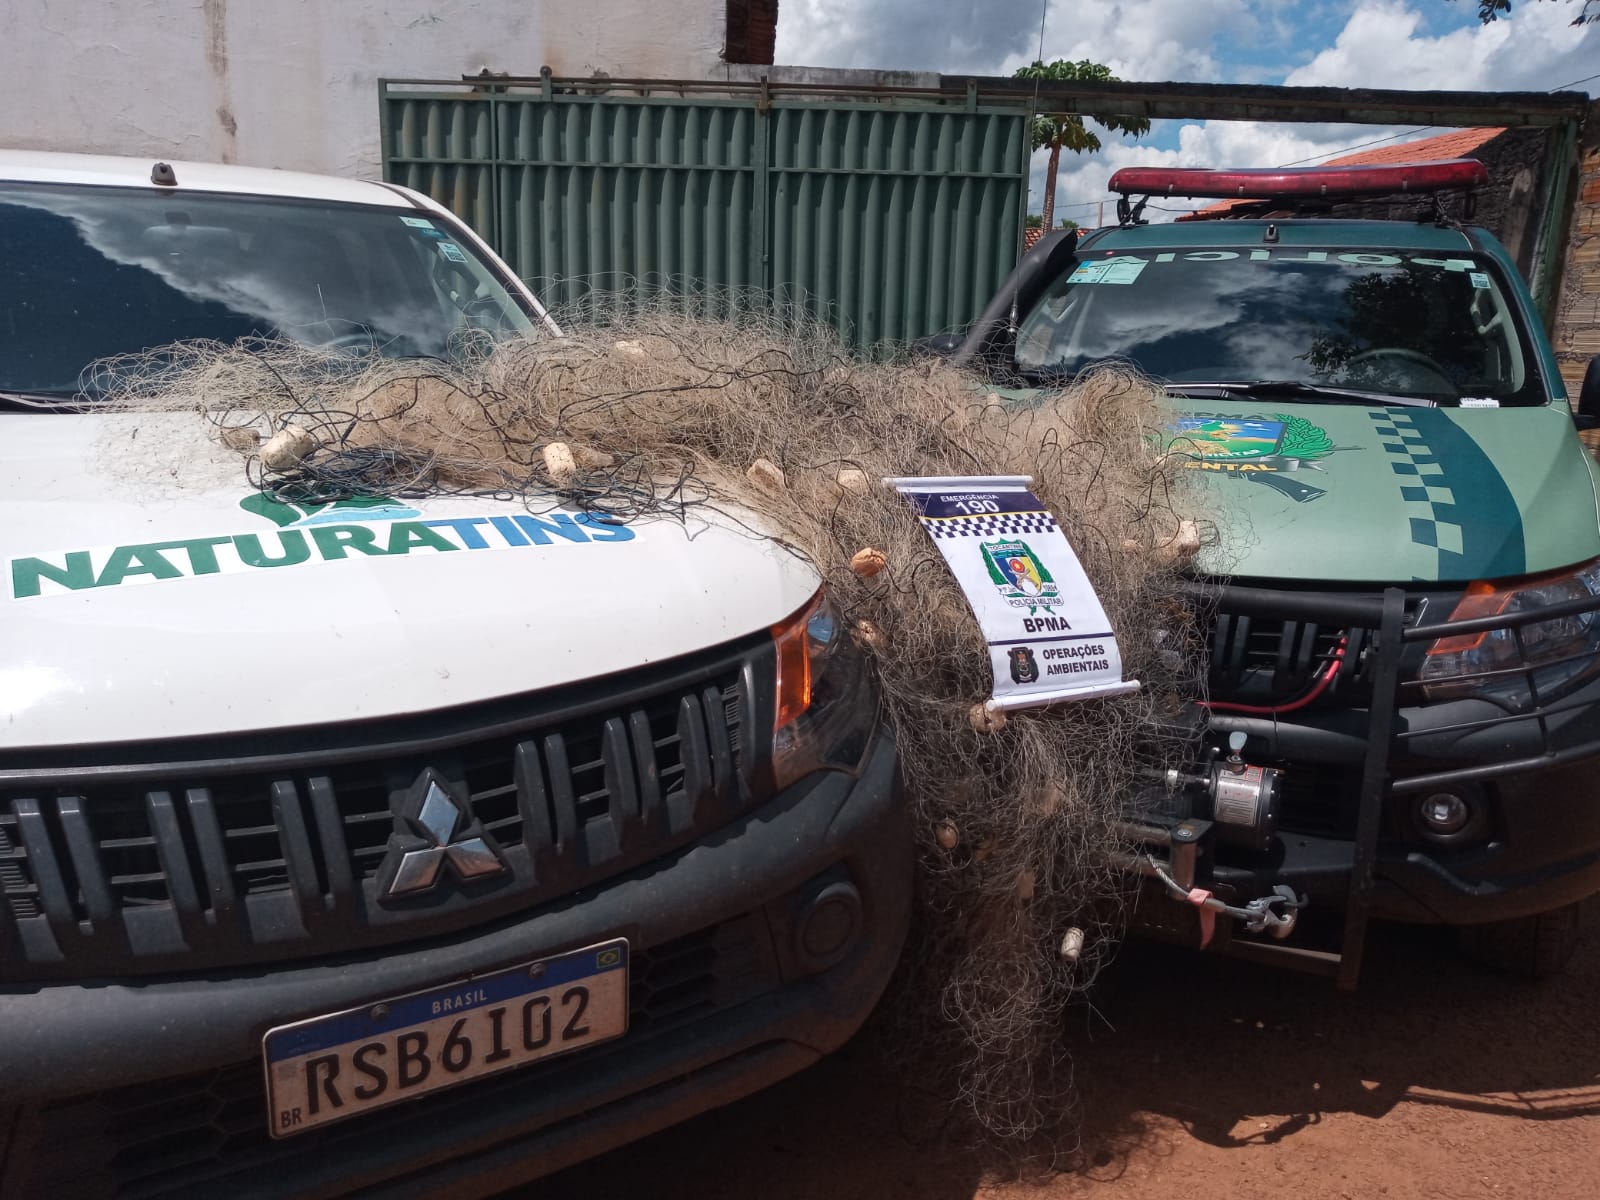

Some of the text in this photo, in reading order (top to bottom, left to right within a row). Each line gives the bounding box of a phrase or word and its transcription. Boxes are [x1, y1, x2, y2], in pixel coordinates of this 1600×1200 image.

[1184, 462, 1278, 471] ENTAL
[940, 494, 1000, 502] EMERGÊNCIA
[956, 500, 1000, 514] 190
[11, 513, 637, 600] NATURATINS
[1023, 616, 1072, 633] BPMA
[1043, 645, 1105, 660] OPERAÇÕES
[1047, 660, 1109, 676] AMBIENTAIS
[432, 989, 488, 1014] BRASIL
[305, 985, 590, 1115] RSB6I02
[280, 1109, 302, 1129] BR
